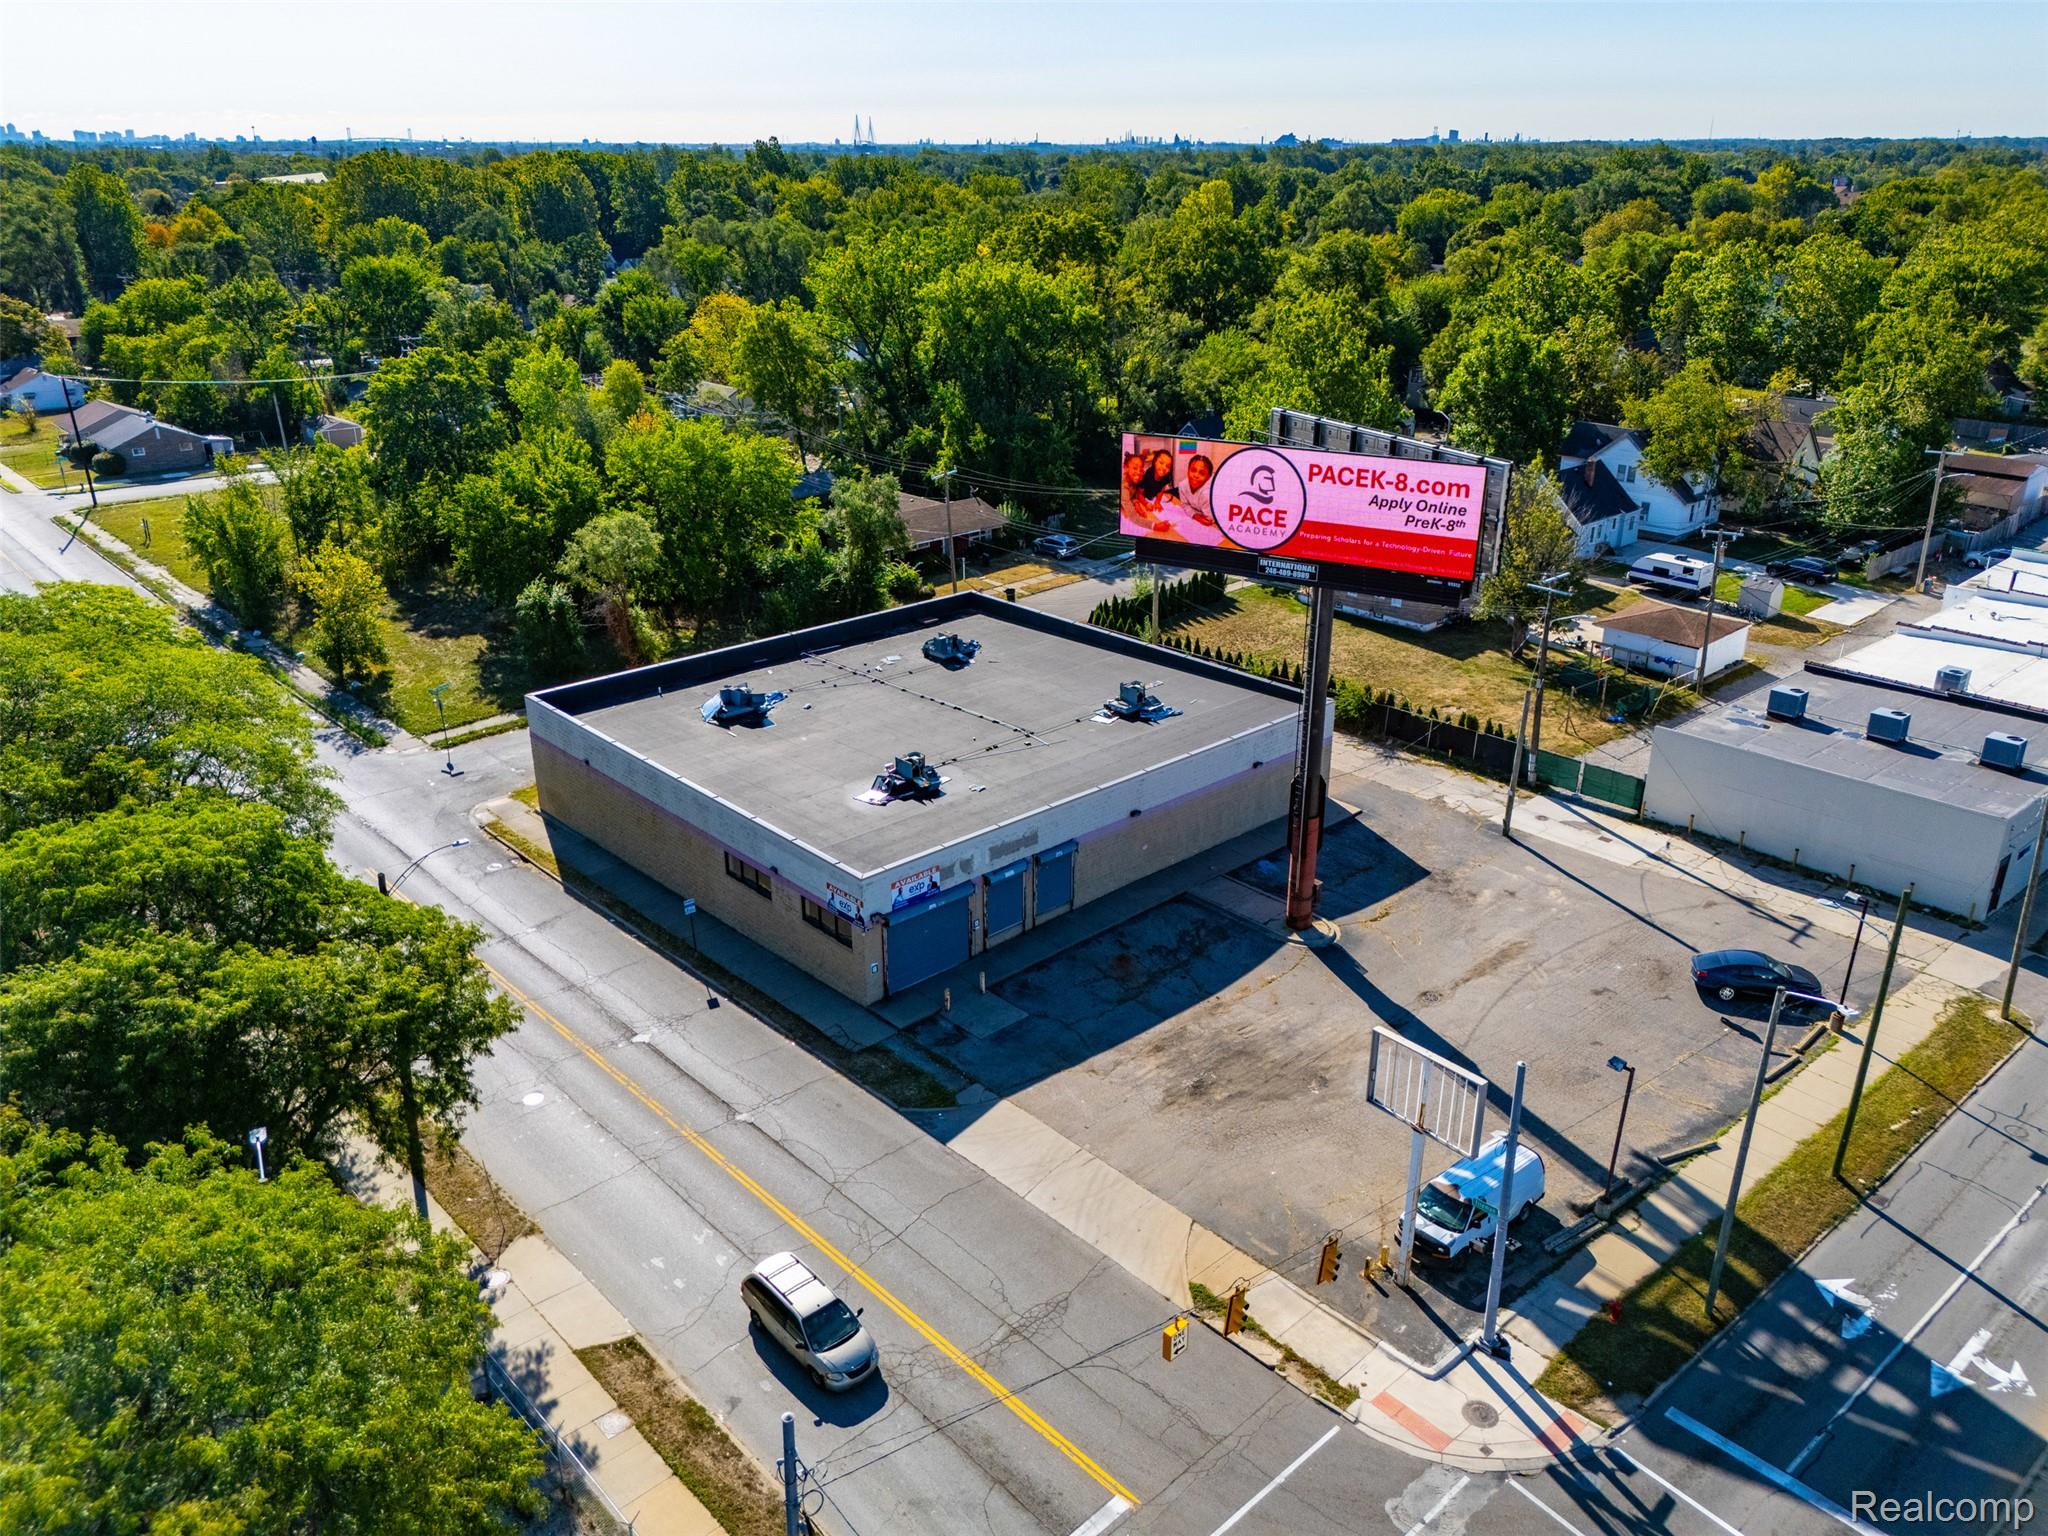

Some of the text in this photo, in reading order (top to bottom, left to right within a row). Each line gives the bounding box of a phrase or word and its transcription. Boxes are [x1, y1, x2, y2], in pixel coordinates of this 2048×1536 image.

[1308, 463, 1470, 498] PACEK-8.com
[1228, 504, 1288, 528] PACE
[1368, 494, 1467, 517] Apply Online
[1228, 524, 1287, 538] ACADEMY
[1404, 514, 1466, 533] PreK-8th
[1300, 531, 1331, 542] Preparing
[1333, 535, 1361, 545] Scholars
[1363, 538, 1373, 546] for
[1382, 541, 1446, 556] Technology-Driven
[1448, 549, 1473, 559] Future
[1260, 559, 1316, 573] INTERNATIONAL
[895, 867, 937, 889] AVAILABLE
[908, 881, 926, 896] exp
